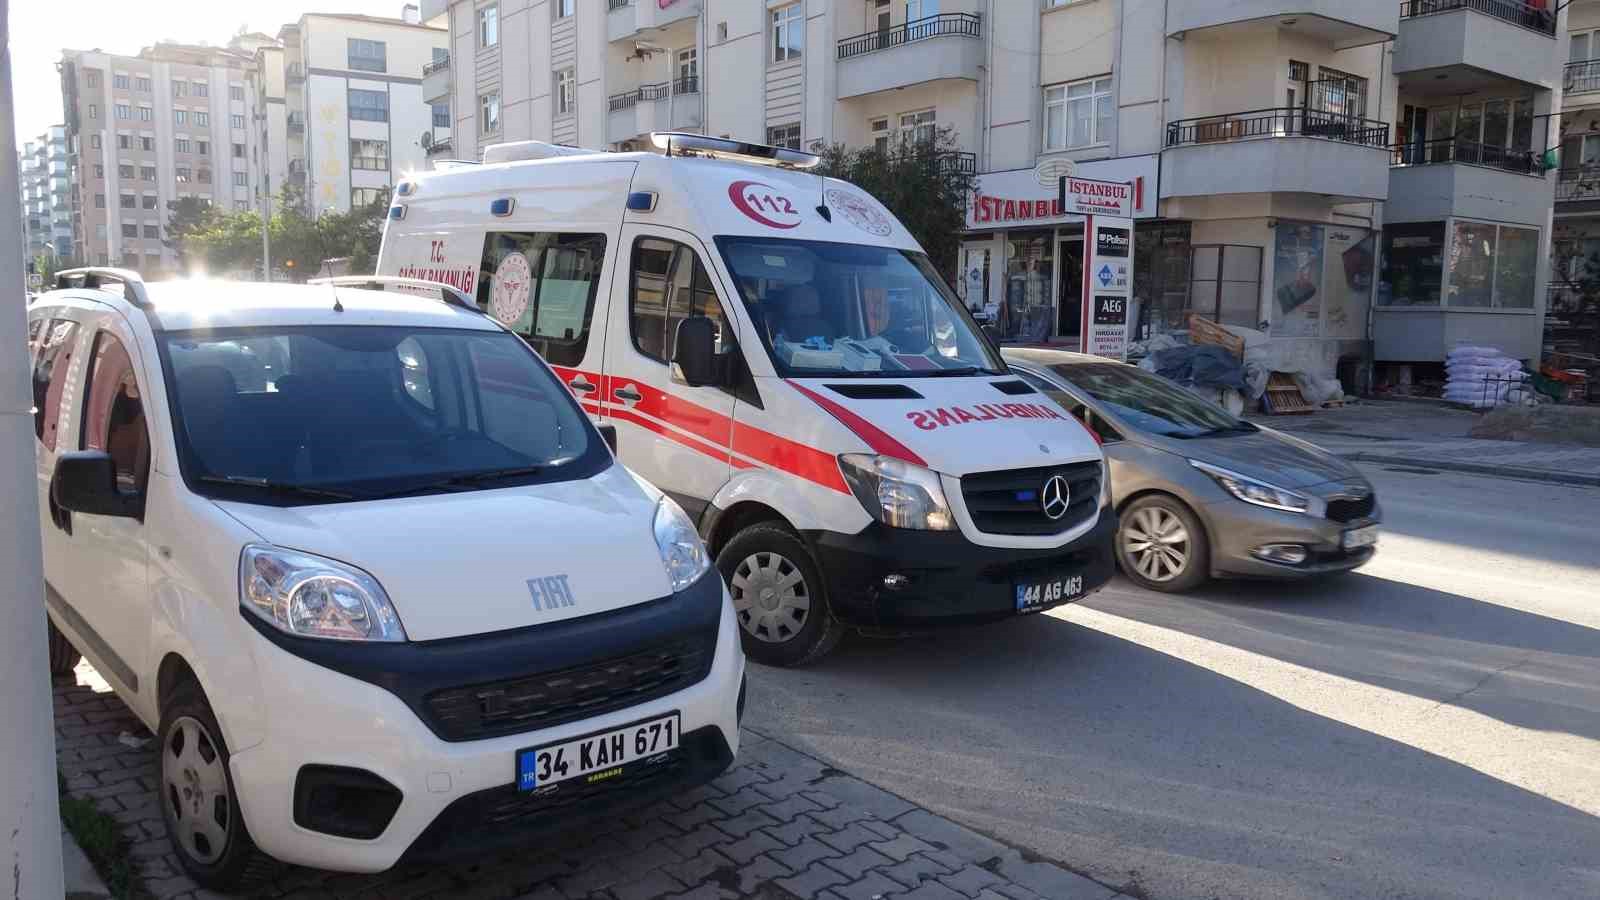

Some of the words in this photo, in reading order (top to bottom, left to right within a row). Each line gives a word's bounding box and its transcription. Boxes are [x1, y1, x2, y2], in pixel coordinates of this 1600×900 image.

[1069, 179, 1128, 199] İSTANBUL
[747, 193, 799, 215] 112
[430, 240, 446, 263] T.C.
[1102, 299, 1122, 313] AEG
[526, 574, 576, 612] FIAT
[1024, 584, 1041, 604] 44
[1043, 581, 1062, 602] AG
[1064, 576, 1082, 597] 463
[537, 747, 569, 782] 34
[580, 733, 625, 771] KAH
[634, 719, 673, 755] 671
